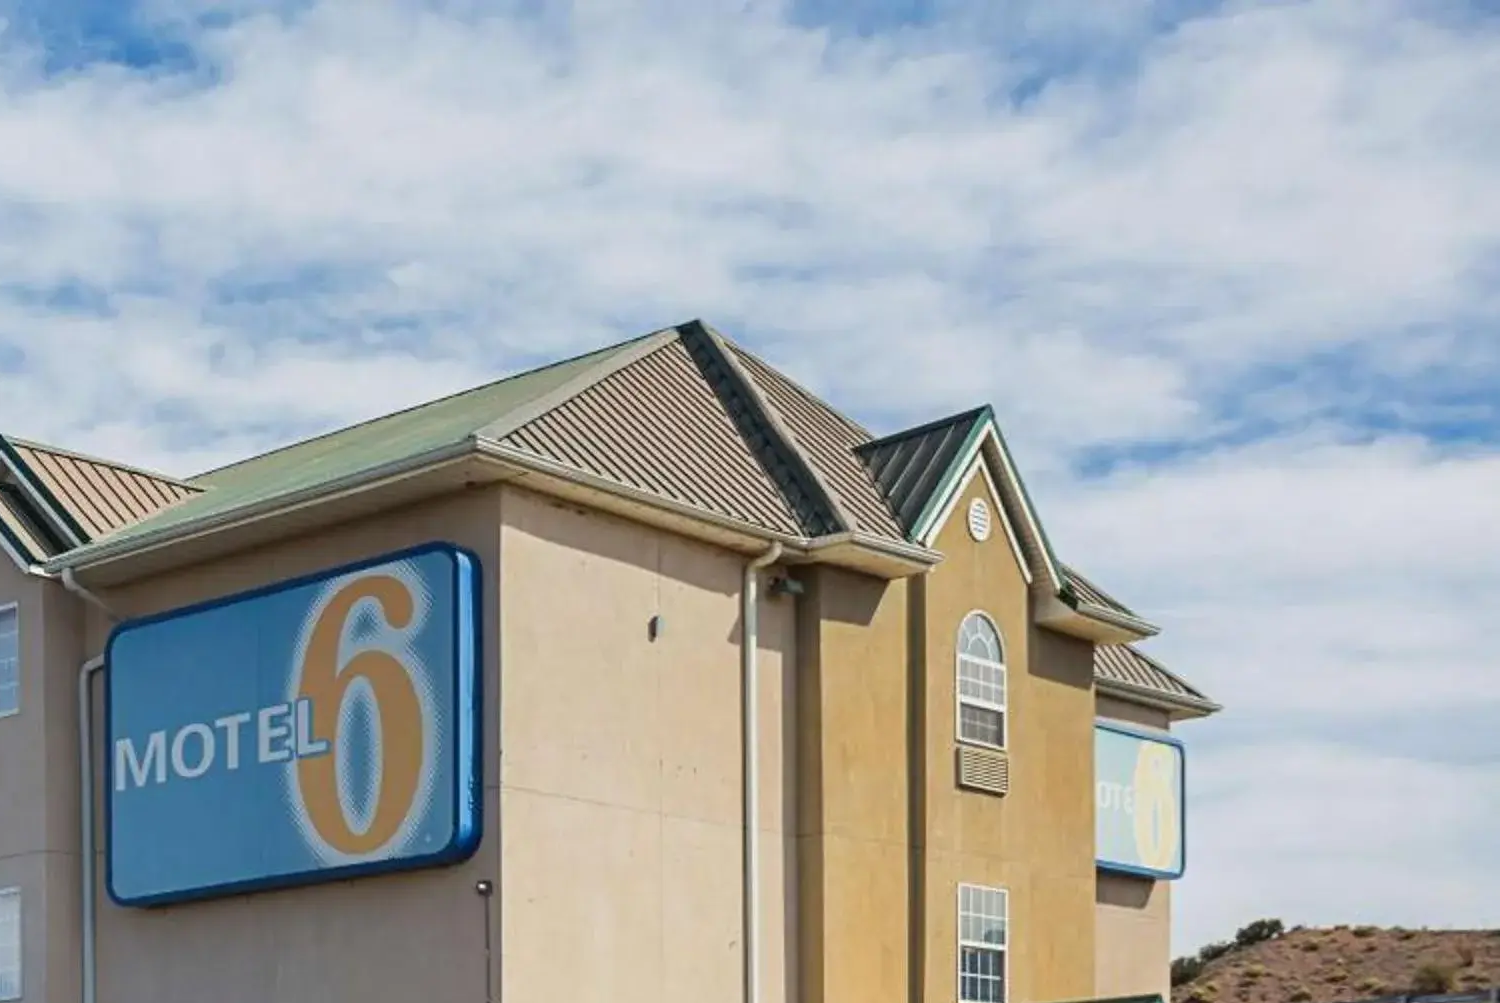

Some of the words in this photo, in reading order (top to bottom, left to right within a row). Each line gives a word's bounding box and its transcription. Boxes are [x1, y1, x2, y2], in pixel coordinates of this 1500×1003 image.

[114, 699, 331, 792] MOTEL
[297, 572, 425, 856] 6
[1096, 780, 1134, 815] OTE
